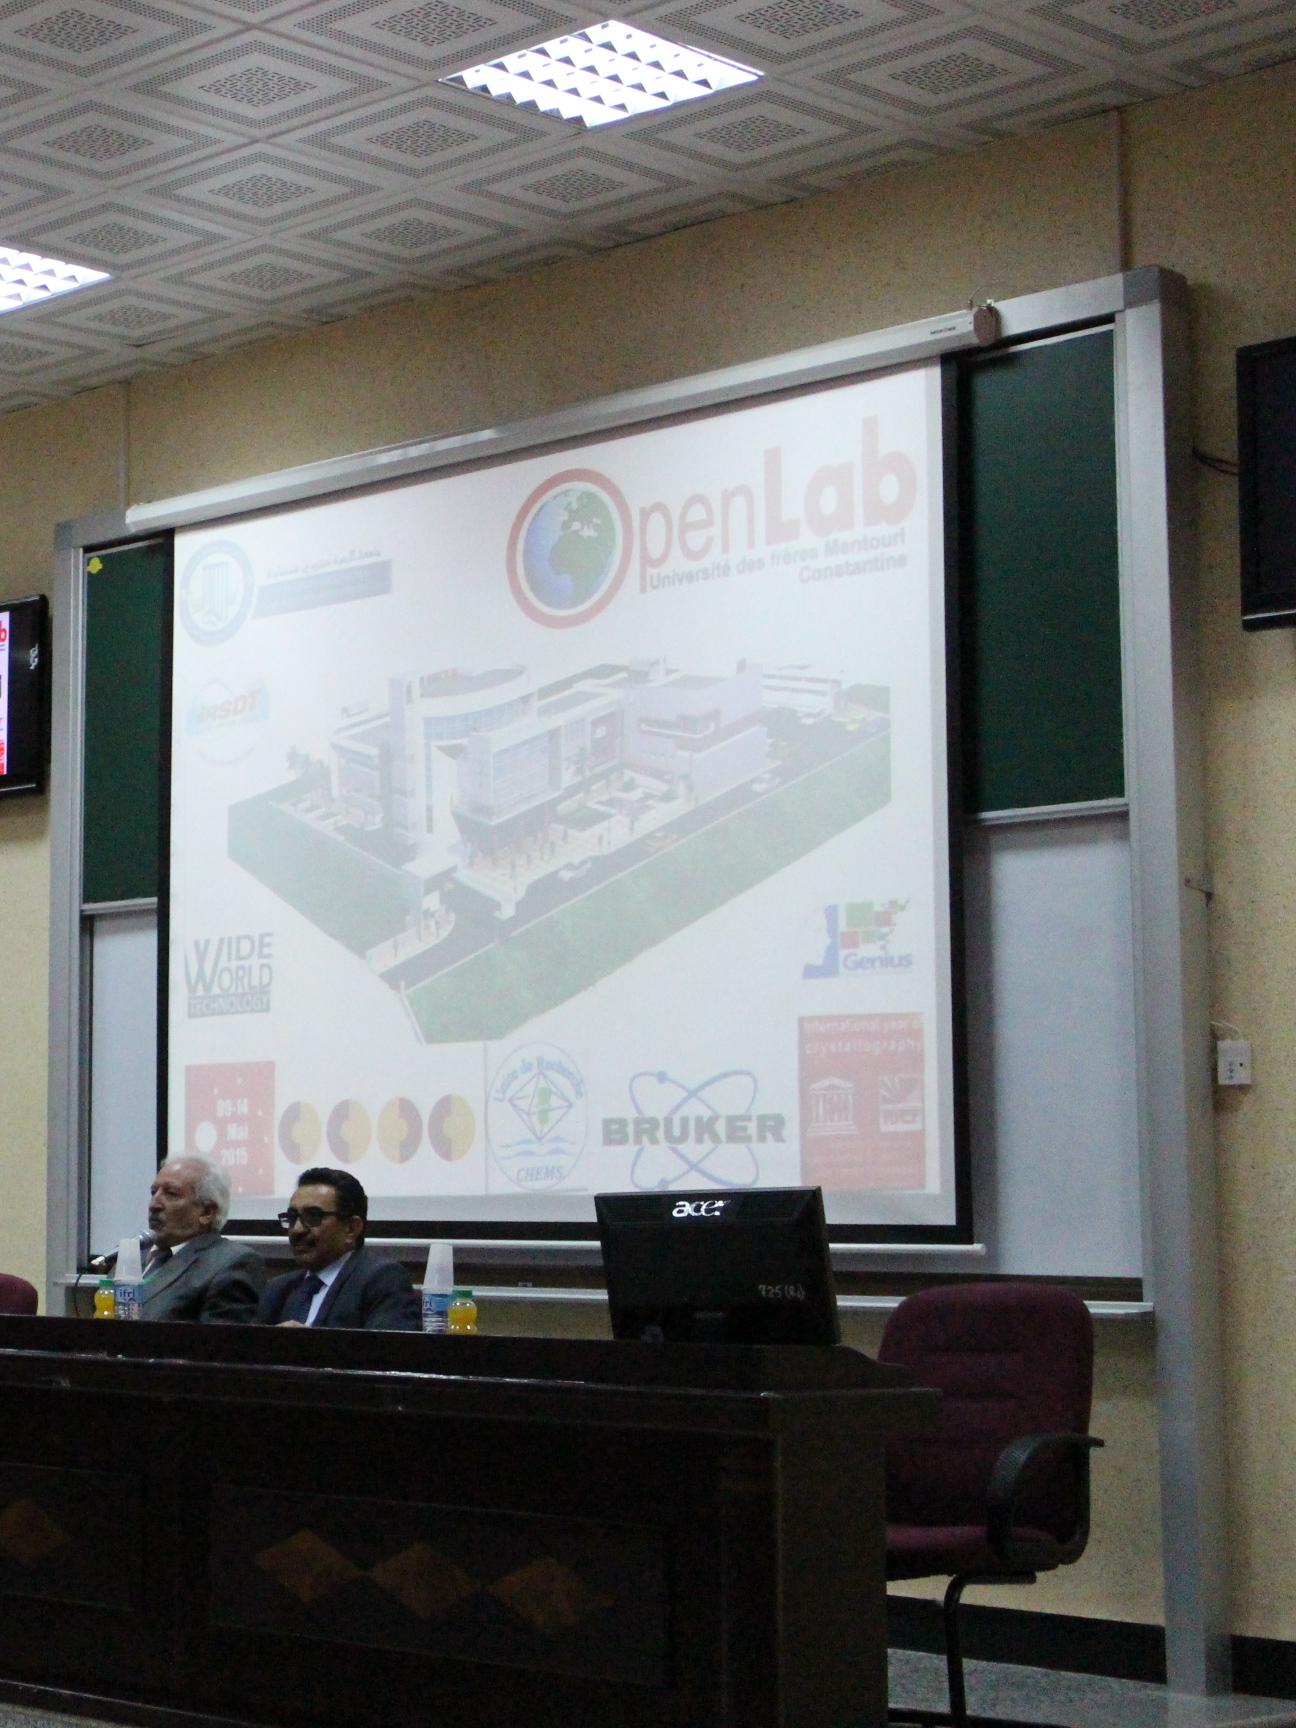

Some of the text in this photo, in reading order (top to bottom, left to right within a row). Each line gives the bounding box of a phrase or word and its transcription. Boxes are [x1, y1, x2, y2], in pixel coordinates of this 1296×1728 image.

[648, 560, 732, 591] Université
[735, 556, 766, 576] des
[770, 545, 819, 570] frères
[799, 551, 908, 585] Constantine
[184, 932, 274, 964] WIDE
[842, 952, 914, 972] Genius
[184, 960, 273, 995] WORLD
[189, 994, 270, 1016] TECHNOLOGY
[217, 1098, 249, 1118] 09-14
[227, 1123, 249, 1142] Mai
[602, 1113, 787, 1146] BRUKER
[221, 1147, 249, 1166] 2015
[516, 1166, 564, 1182] CHEMS
[672, 1200, 731, 1217] acer
